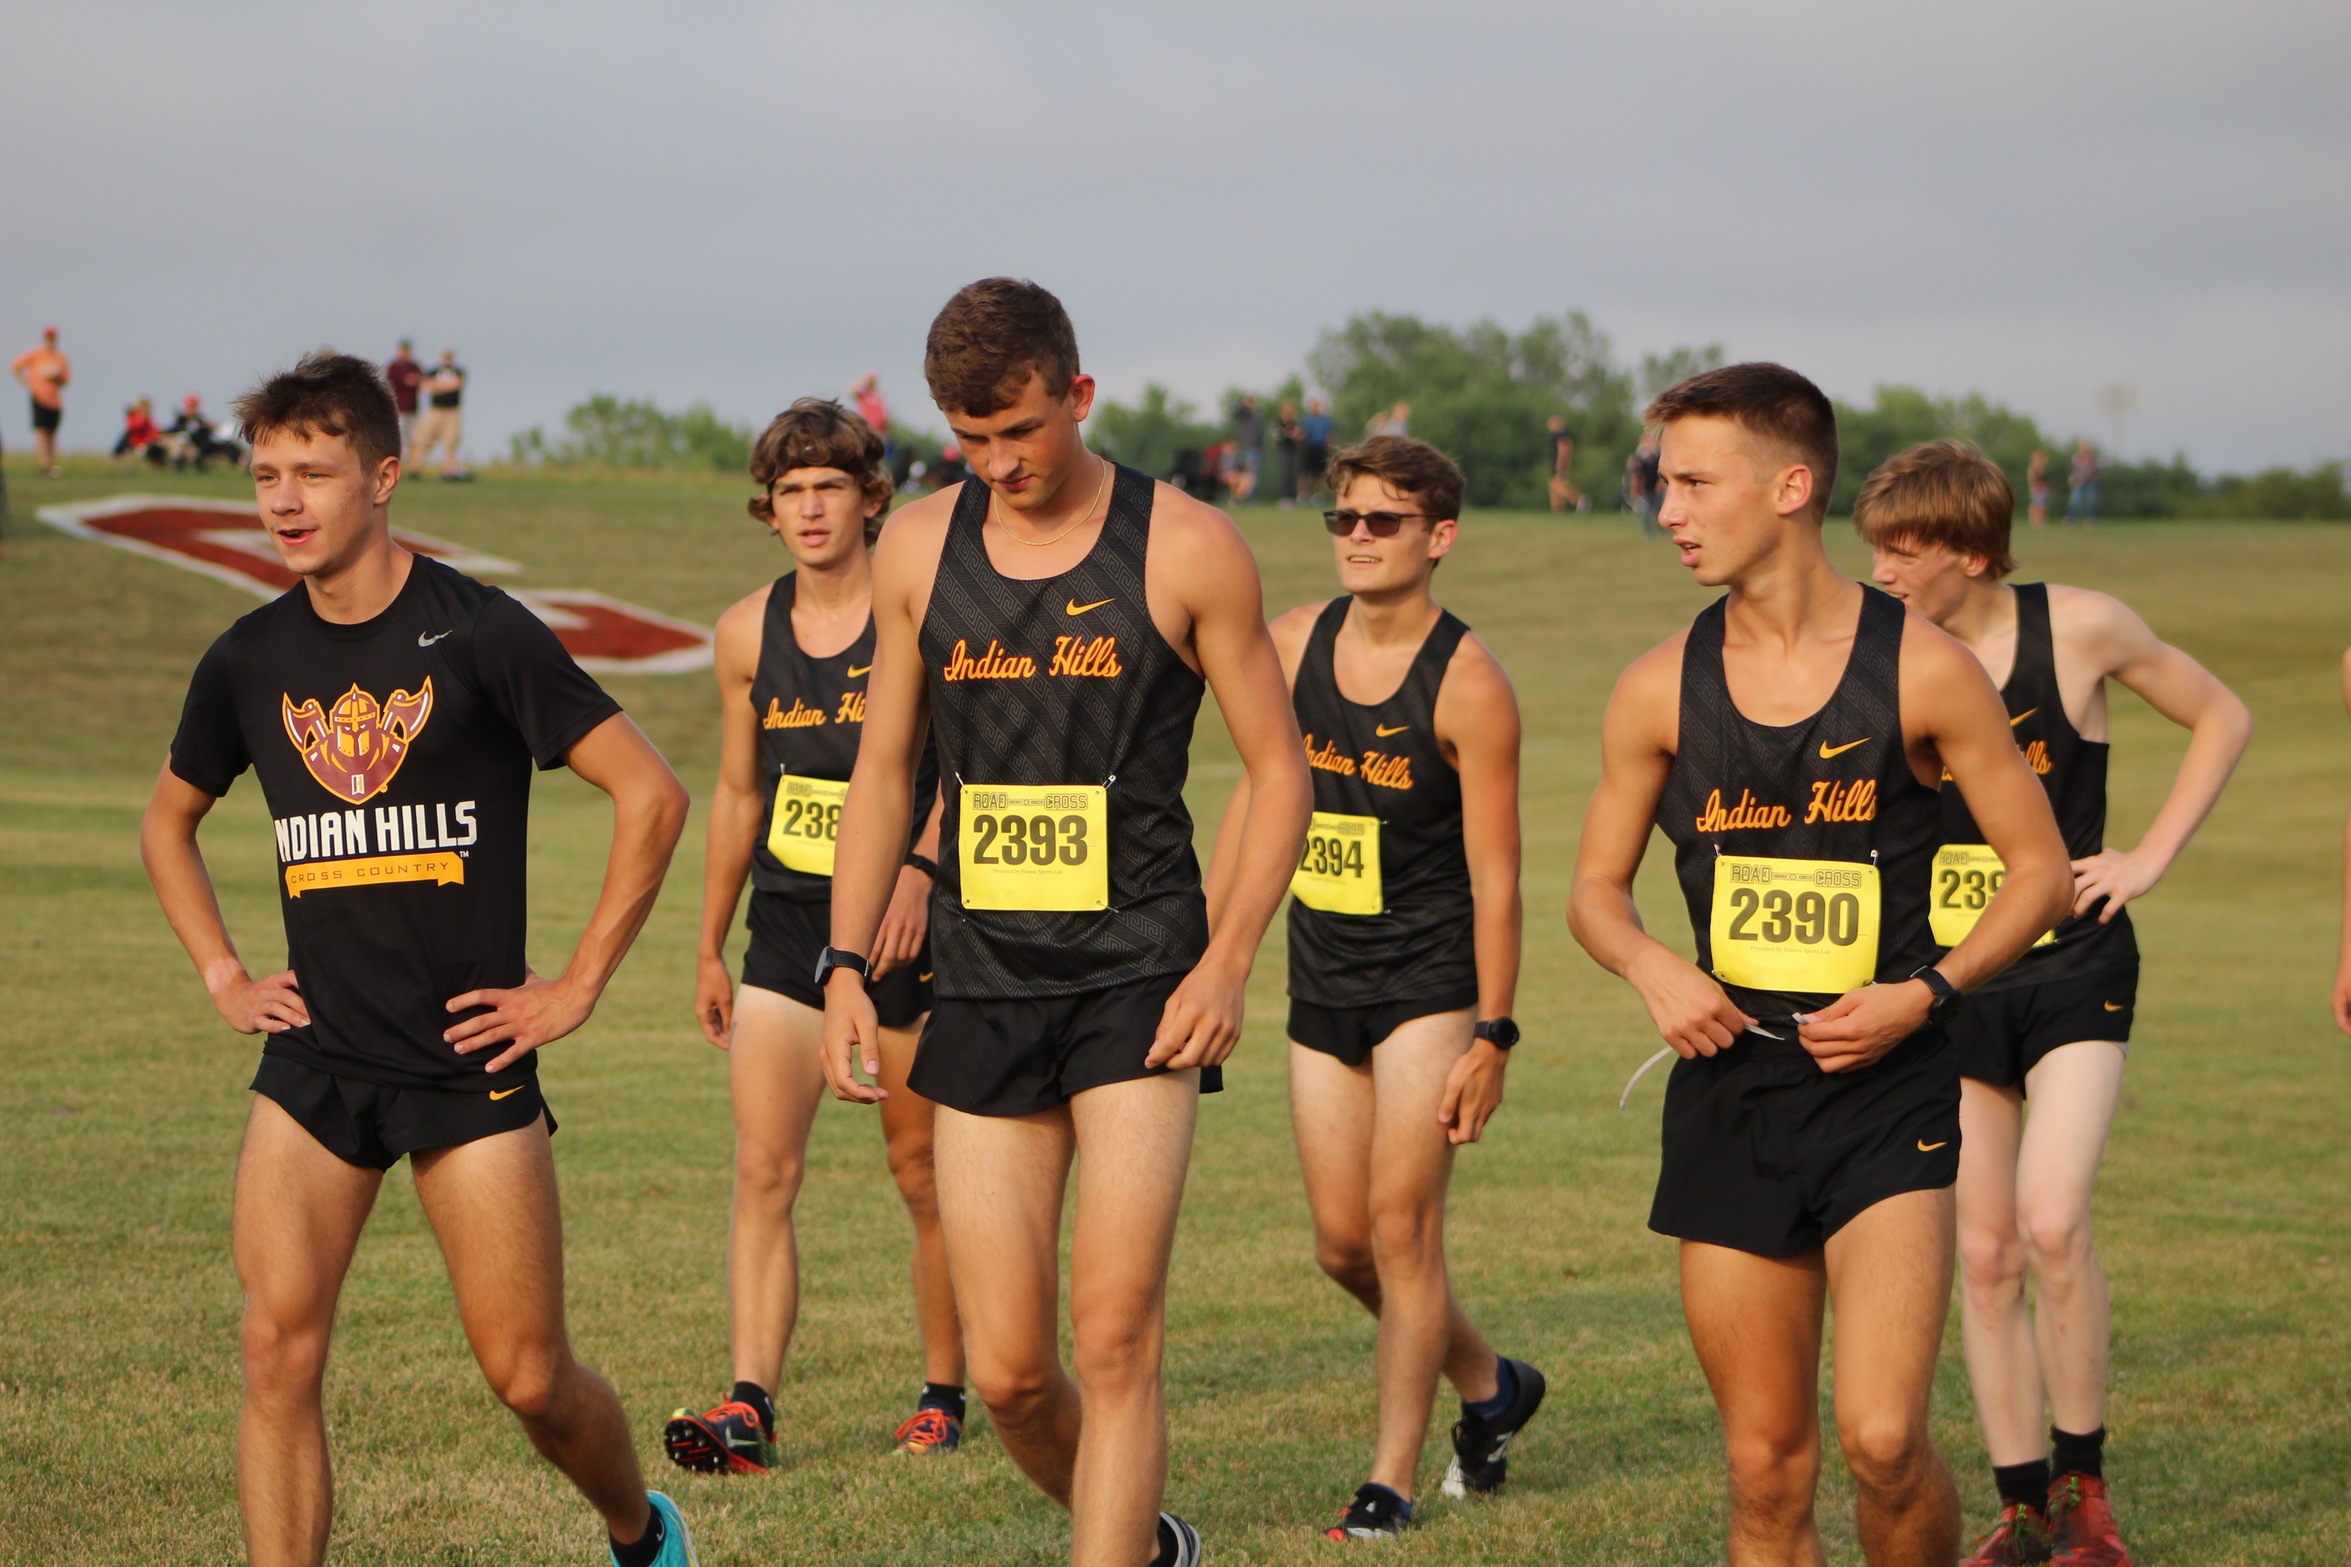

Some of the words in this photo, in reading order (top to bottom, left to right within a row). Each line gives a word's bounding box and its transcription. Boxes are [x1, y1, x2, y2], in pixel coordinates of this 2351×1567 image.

[944, 638, 1036, 682] Indian
[1049, 635, 1123, 678] Hills
[763, 697, 827, 730] Indian
[1360, 749, 1414, 790] Hills
[2022, 740, 2052, 775] lls
[782, 799, 841, 842] 238
[973, 792, 1007, 810] ROAD
[1045, 793, 1088, 810] CROSS
[1696, 787, 1792, 832] Indian
[1804, 779, 1877, 825] Hills
[274, 809, 367, 862] NDIAN
[375, 800, 477, 852] HILLS
[973, 814, 1088, 866] 2393
[291, 870, 342, 883] CROSS
[357, 862, 448, 876] COUNTRY
[1298, 836, 1364, 878] 2394
[1731, 864, 1772, 884] ROAD
[1815, 870, 1861, 888] CROSS
[1728, 887, 1860, 946] 2390
